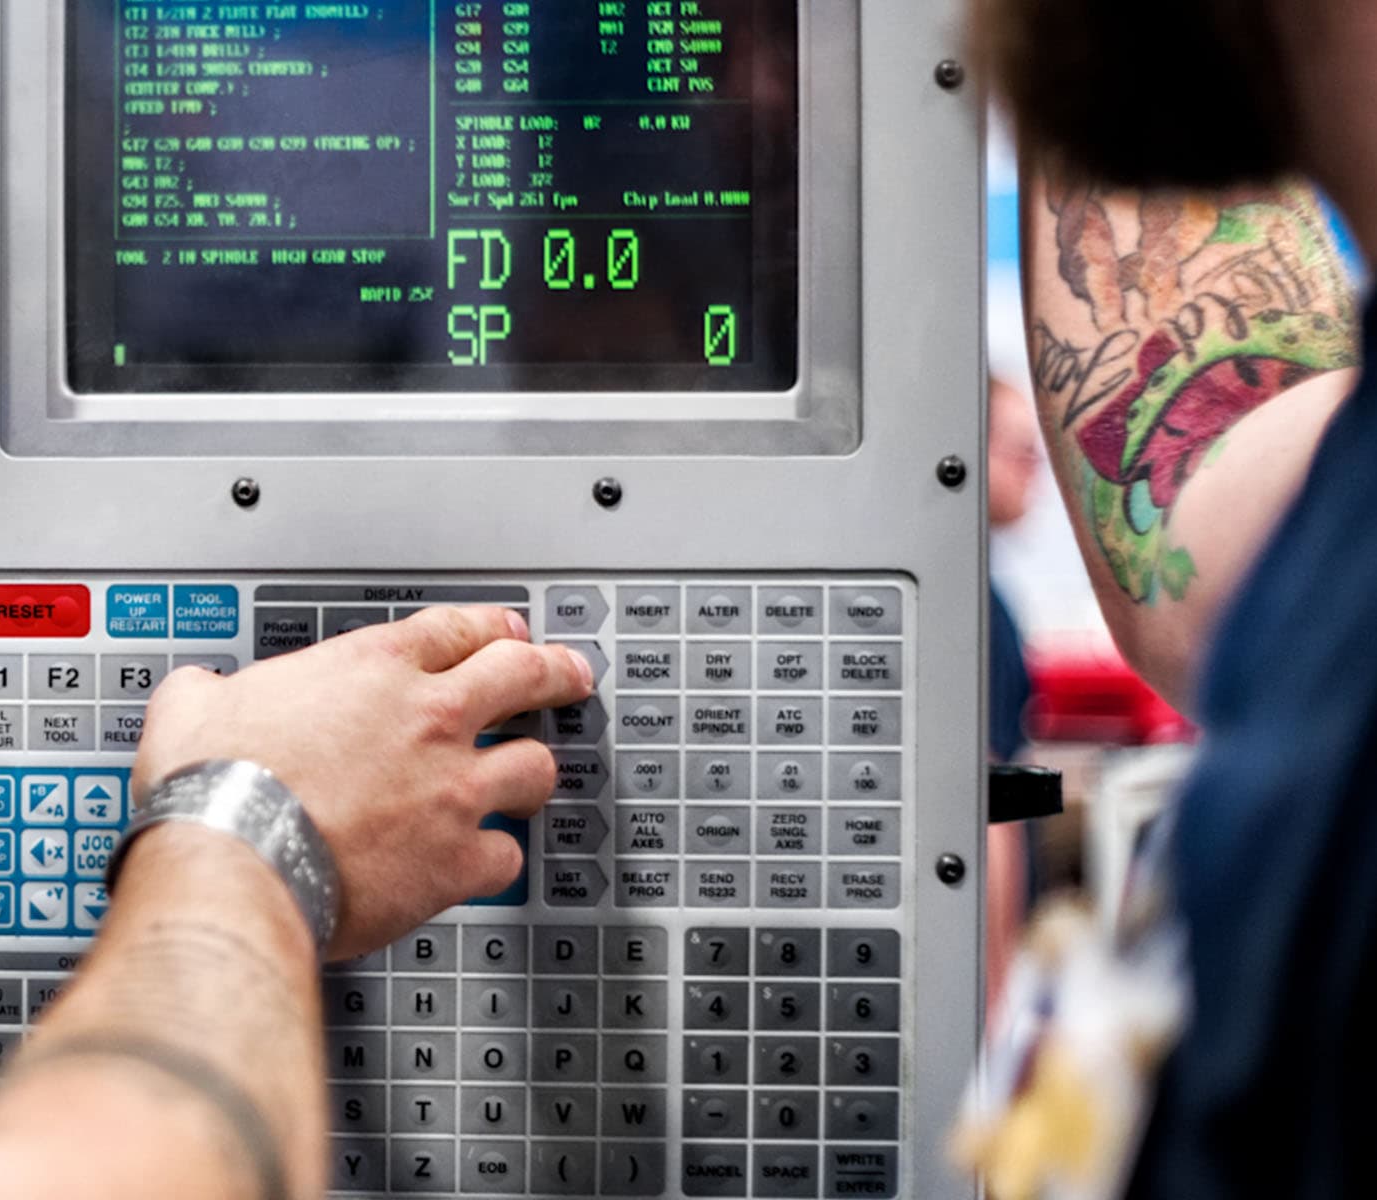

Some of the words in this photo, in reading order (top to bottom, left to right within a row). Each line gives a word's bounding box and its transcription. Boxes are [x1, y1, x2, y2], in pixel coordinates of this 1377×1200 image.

[455, 117, 513, 131] SPINDLE
[671, 116, 691, 130] KW
[455, 136, 466, 150] X
[116, 251, 148, 265] TOOL
[162, 251, 172, 264] 2
[179, 251, 196, 264] IN
[202, 250, 258, 264] SPINDLE
[272, 250, 306, 264] HIGH
[313, 250, 345, 264] GEAR
[353, 250, 385, 264] STOP
[448, 229, 511, 288] FD
[544, 229, 638, 288] 0.0
[361, 287, 401, 302] RAPID
[448, 306, 511, 365] SP
[705, 306, 735, 365] 0
[115, 594, 161, 604] POWER
[190, 593, 222, 604] TOOL
[364, 589, 423, 600] DISPLAY
[129, 607, 145, 617] UP
[175, 607, 236, 618] CHANGER
[557, 606, 584, 617] EDIT
[626, 606, 670, 617] INSERT
[699, 606, 740, 617] ALTER
[766, 606, 814, 617] DELETE
[848, 606, 884, 618] UNDO
[110, 621, 166, 632] RESTART
[176, 621, 235, 632] RESTORE
[263, 622, 308, 634] PRGRM
[260, 636, 311, 647] CONVRS
[626, 654, 671, 665] SINGLE
[706, 654, 731, 665] DRY
[777, 654, 801, 665] OPT
[843, 655, 887, 666] BLOCK
[48, 668, 79, 688] F2
[121, 668, 151, 688] F3
[627, 667, 670, 679] BLOCK
[705, 668, 732, 679] RUN
[774, 668, 807, 679] STOP
[841, 668, 890, 679] DELETE
[695, 709, 741, 720] ORIENT
[777, 709, 801, 720] ATC
[852, 710, 877, 721] ATC
[44, 718, 78, 728] NEXT
[622, 716, 674, 727] COOLNT
[692, 723, 745, 734] SPINDLE
[776, 723, 804, 734] FWD
[853, 723, 878, 734] REV
[44, 731, 78, 742] TOOL
[633, 765, 662, 775] .0001
[707, 765, 730, 775] .001
[781, 765, 798, 775] .01
[557, 778, 584, 789] JOG
[783, 778, 800, 789] 10.
[32, 786, 46, 796] +B
[47, 806, 64, 817] +A
[89, 805, 107, 817] +Z
[552, 818, 586, 829] ZERO
[631, 813, 665, 824] AUTO
[773, 814, 806, 825] ZERO
[845, 820, 882, 831] HOME
[635, 826, 659, 837] ALL
[697, 826, 740, 837] ORIGIN
[771, 827, 807, 837] SINGL
[82, 836, 113, 850] JOG
[558, 833, 582, 844] RET
[631, 838, 664, 849] AXES
[853, 834, 876, 845] G28
[775, 839, 804, 850] AXIS
[47, 846, 64, 859] +X
[555, 872, 582, 883] LIST
[623, 872, 670, 884] SELECT
[700, 873, 734, 884] SEND
[771, 874, 805, 884] RECV
[842, 874, 885, 885] ERASE
[47, 887, 63, 900] +Y
[551, 887, 587, 898] PROG
[629, 886, 664, 897] PROG
[699, 887, 736, 898] RS232
[770, 887, 807, 898] RS232
[846, 888, 882, 899] PROG
[417, 940, 432, 959] B
[486, 940, 504, 959] C
[556, 940, 573, 960] D
[627, 941, 643, 961] E
[709, 942, 724, 962] 7
[781, 943, 796, 963] 8
[856, 944, 872, 964] 9
[416, 993, 432, 1013] H
[492, 994, 497, 1013] I
[558, 995, 571, 1015] J
[626, 996, 643, 1015] K
[709, 996, 723, 1016] 4
[781, 998, 795, 1017] 5
[856, 998, 871, 1018] 6
[416, 1048, 432, 1067] N
[484, 1048, 503, 1068] O
[556, 1050, 572, 1069] P
[625, 1050, 644, 1072] Q
[712, 1052, 722, 1071] 1
[780, 1053, 795, 1073] 2
[855, 1053, 870, 1073] 3
[416, 1101, 431, 1121] T
[485, 1102, 501, 1123] U
[555, 1103, 571, 1123] V
[622, 1104, 646, 1123] W
[779, 1106, 794, 1126] 0
[836, 1154, 885, 1165] WRITE
[415, 1158, 431, 1177] Z
[478, 1162, 507, 1174] EOB
[686, 1166, 742, 1177] CANCEL
[763, 1166, 810, 1178] SPACE
[836, 1182, 885, 1193] ENTER
